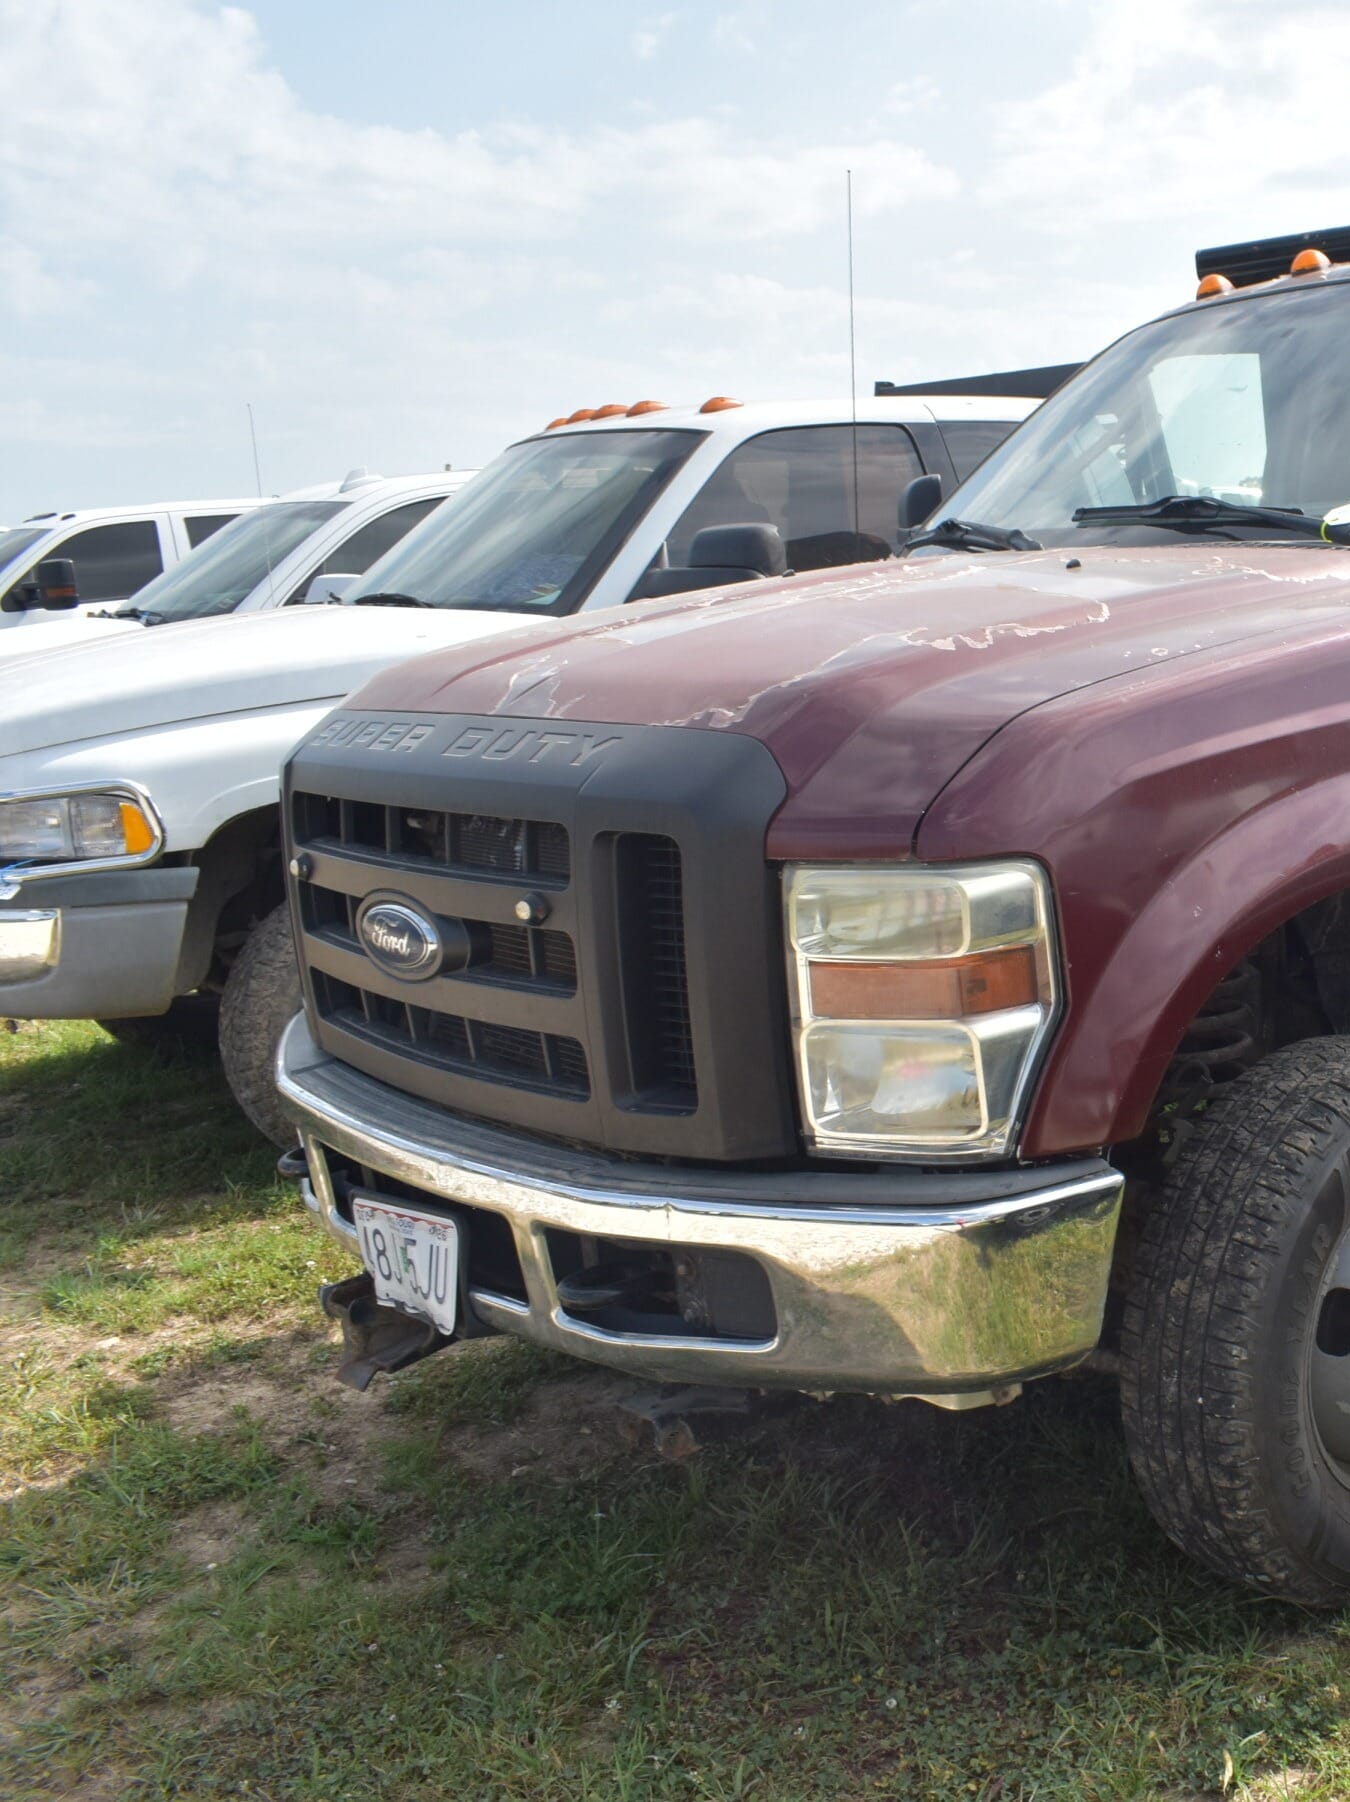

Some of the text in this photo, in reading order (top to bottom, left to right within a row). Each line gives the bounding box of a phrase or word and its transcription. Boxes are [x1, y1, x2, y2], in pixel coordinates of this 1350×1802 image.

[312, 719, 624, 767] SUPER DUTY
[371, 915, 411, 957] Ford
